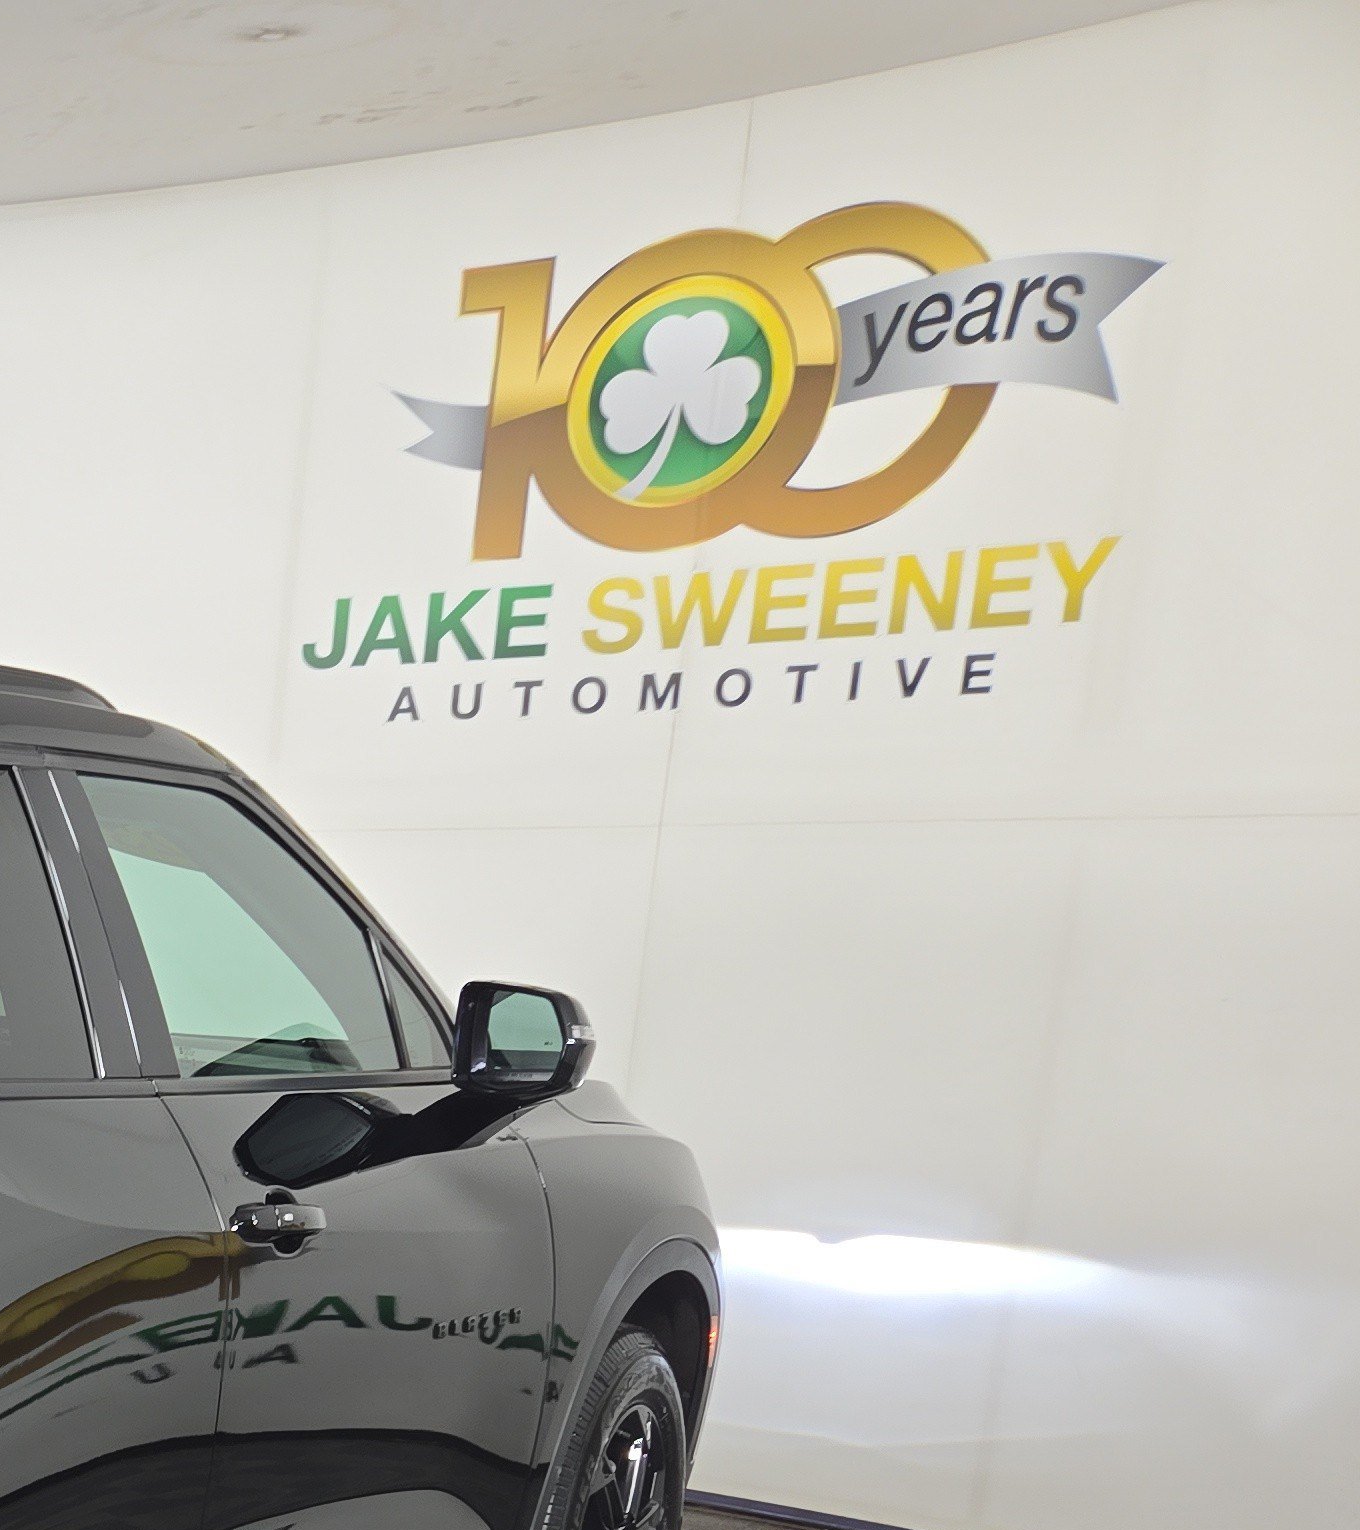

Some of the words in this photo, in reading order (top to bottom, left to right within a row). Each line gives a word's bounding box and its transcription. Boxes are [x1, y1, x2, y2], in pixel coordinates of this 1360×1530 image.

[459, 201, 1000, 561] 100
[853, 272, 1086, 386] years
[302, 584, 554, 670] JAKE
[581, 536, 1121, 655] SWEENEY
[386, 652, 997, 724] AUTOMOTIVE
